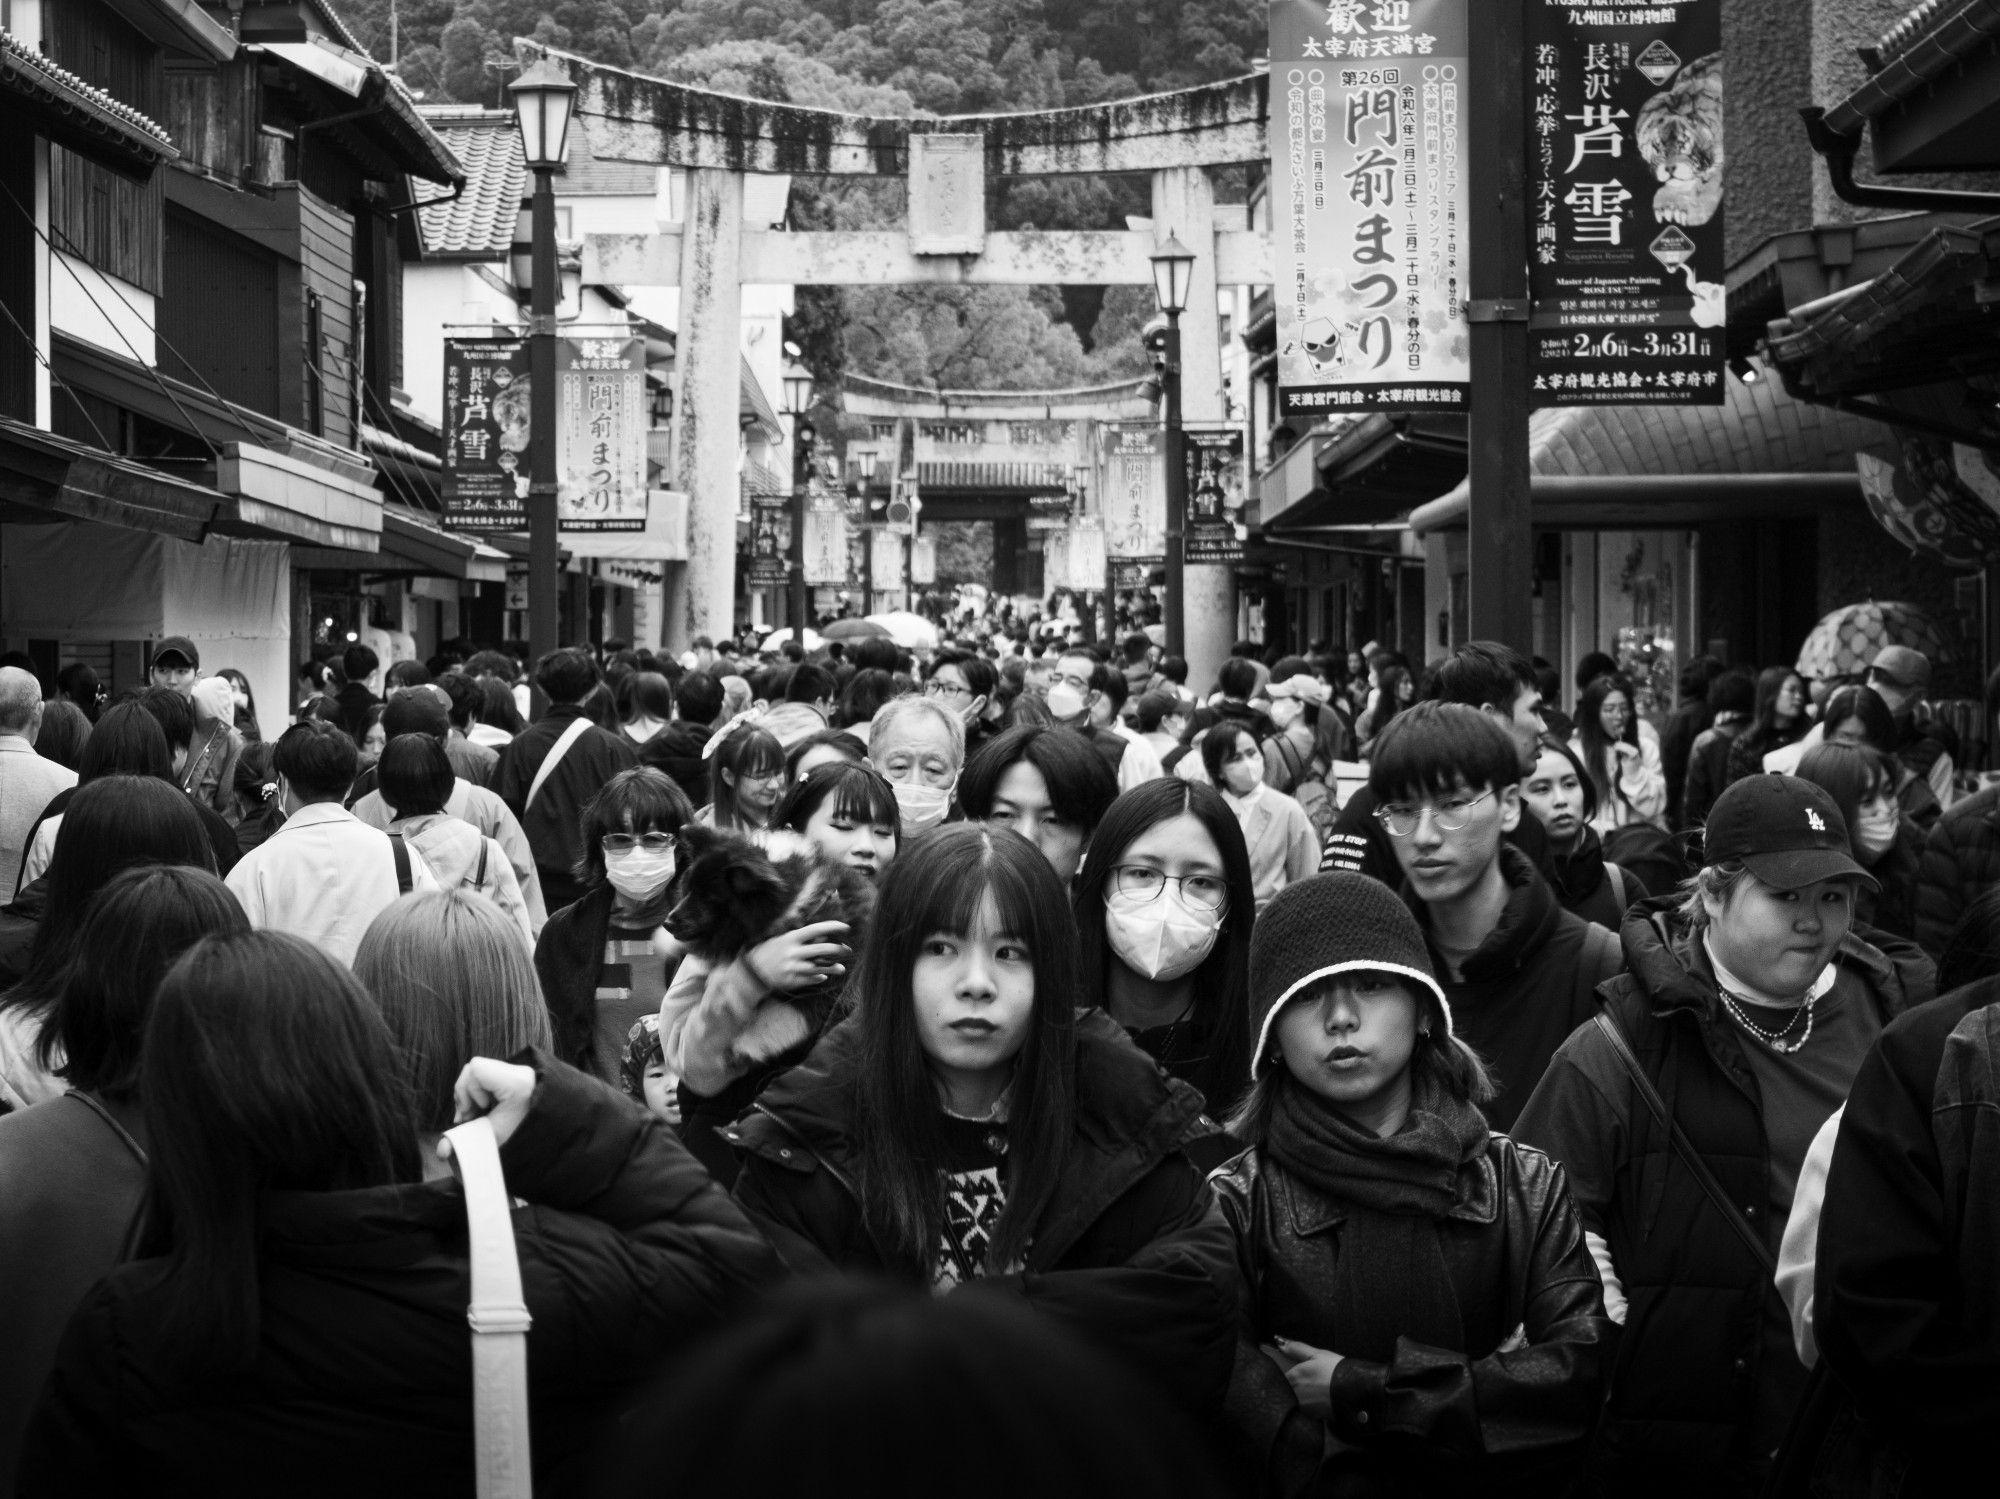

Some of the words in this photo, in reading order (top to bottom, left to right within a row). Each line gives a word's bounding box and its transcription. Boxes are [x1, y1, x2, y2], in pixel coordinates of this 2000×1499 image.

[1568, 7, 1676, 25] 九州国立博物館
[1302, 33, 1437, 57] 太宰府天満宮
[1341, 69, 1400, 87] 第26回
[1344, 87, 1398, 371] 門前まつり
[1556, 278, 1582, 286] Master
[1584, 278, 1592, 286] of
[1593, 278, 1627, 287] Japanese
[1629, 277, 1661, 286] Painting
[1533, 370, 1718, 390] 太宰府観光協会・太宰府市
[1288, 389, 1462, 407] 天満宮門前会・太宰府観光協会
[589, 385, 612, 513] 門前まつり
[1805, 808, 1825, 830] LA
